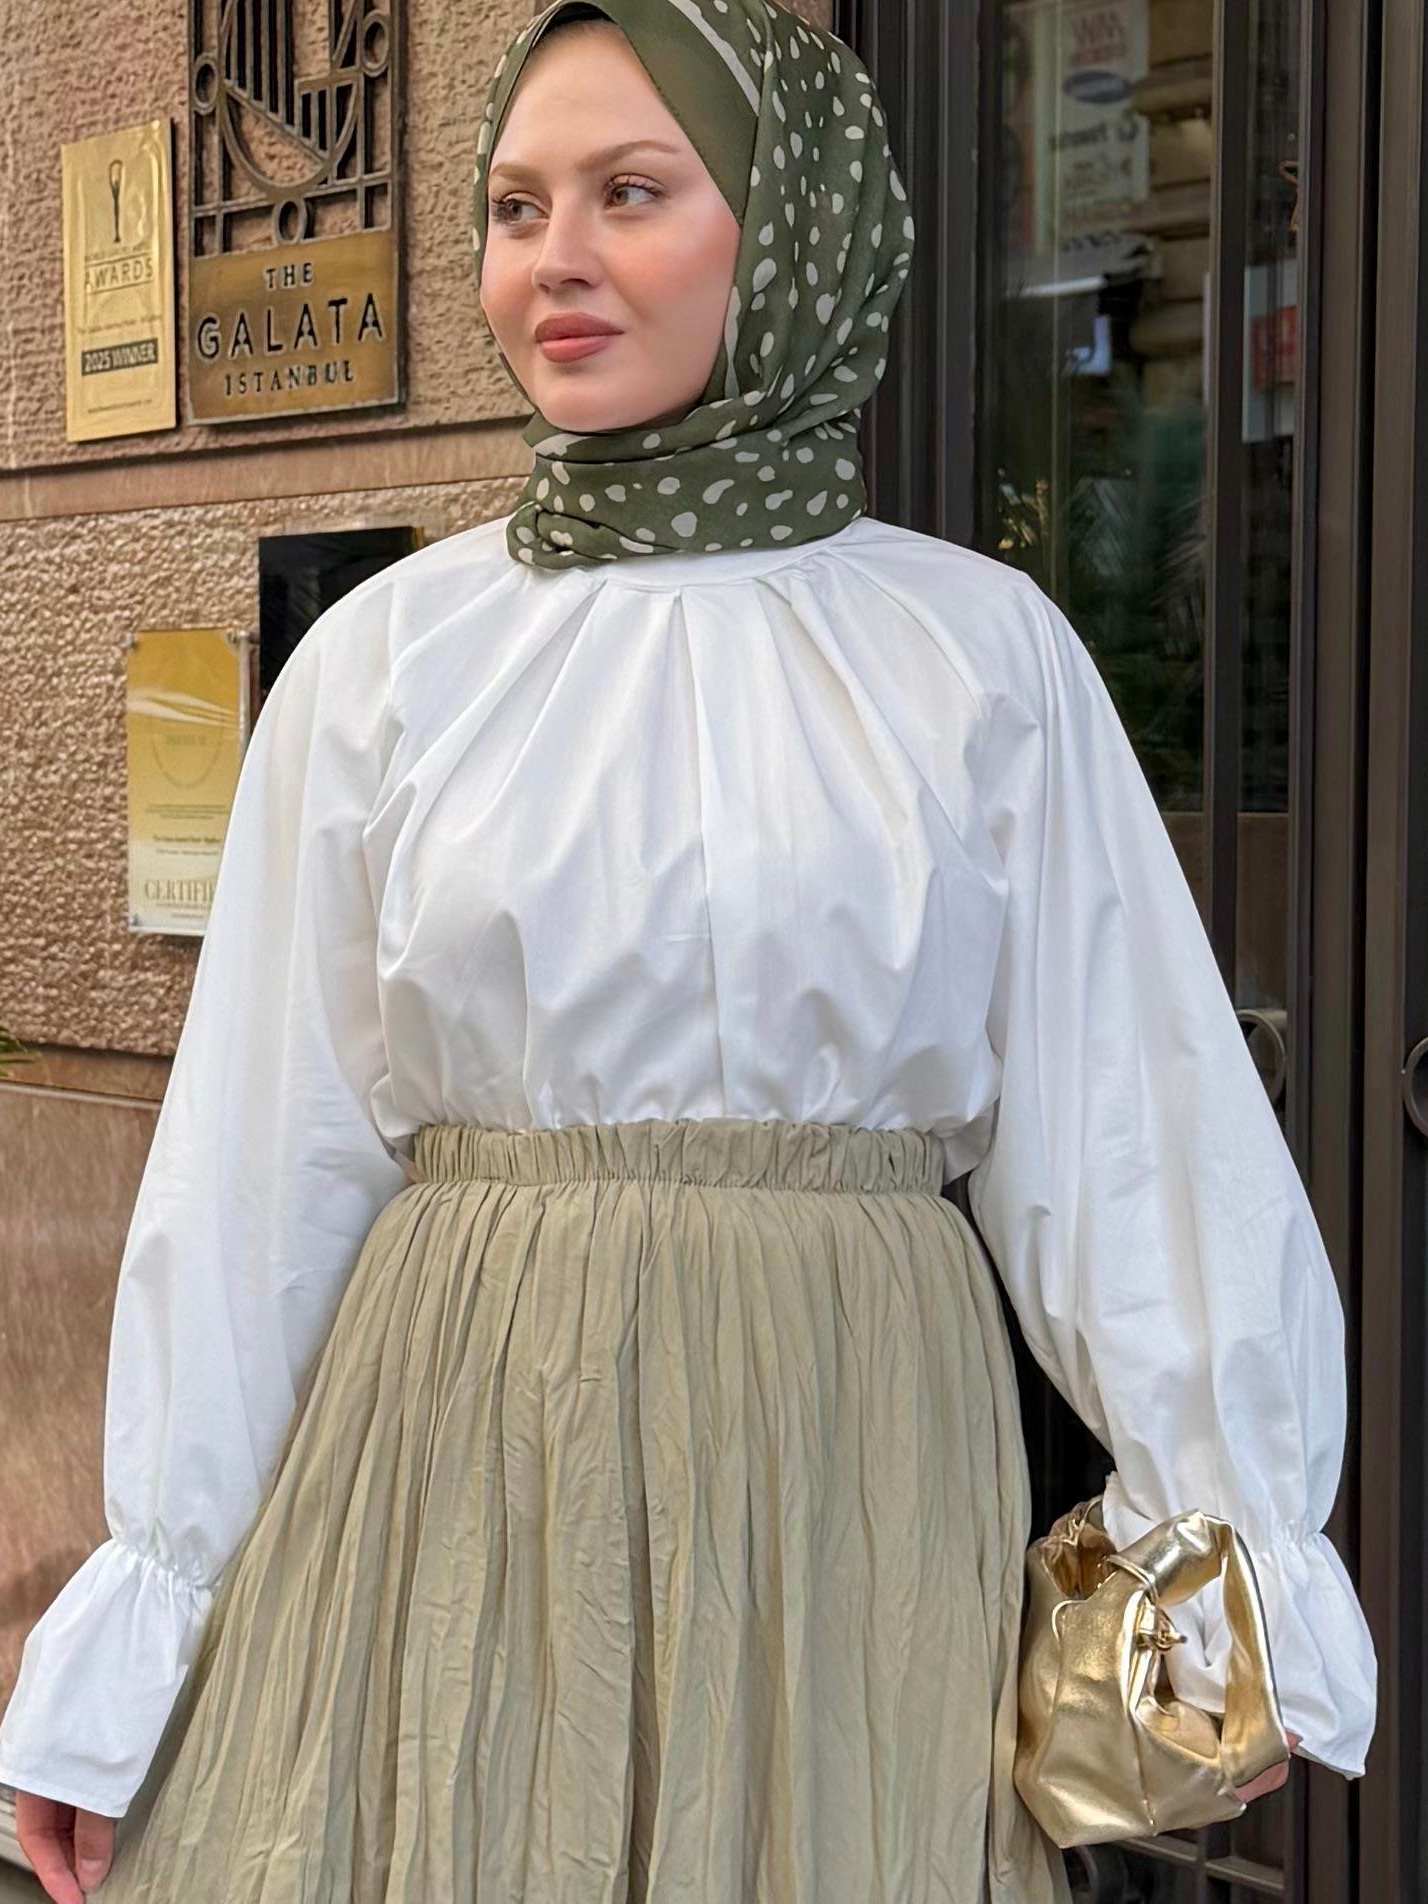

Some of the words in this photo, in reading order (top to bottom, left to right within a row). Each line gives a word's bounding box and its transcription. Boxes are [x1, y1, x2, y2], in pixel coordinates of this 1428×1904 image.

[84, 258, 154, 290] AWARDS
[265, 262, 314, 290] THE
[197, 292, 384, 360] GALATA
[84, 349, 111, 372] 2025
[112, 342, 156, 369] WINNER
